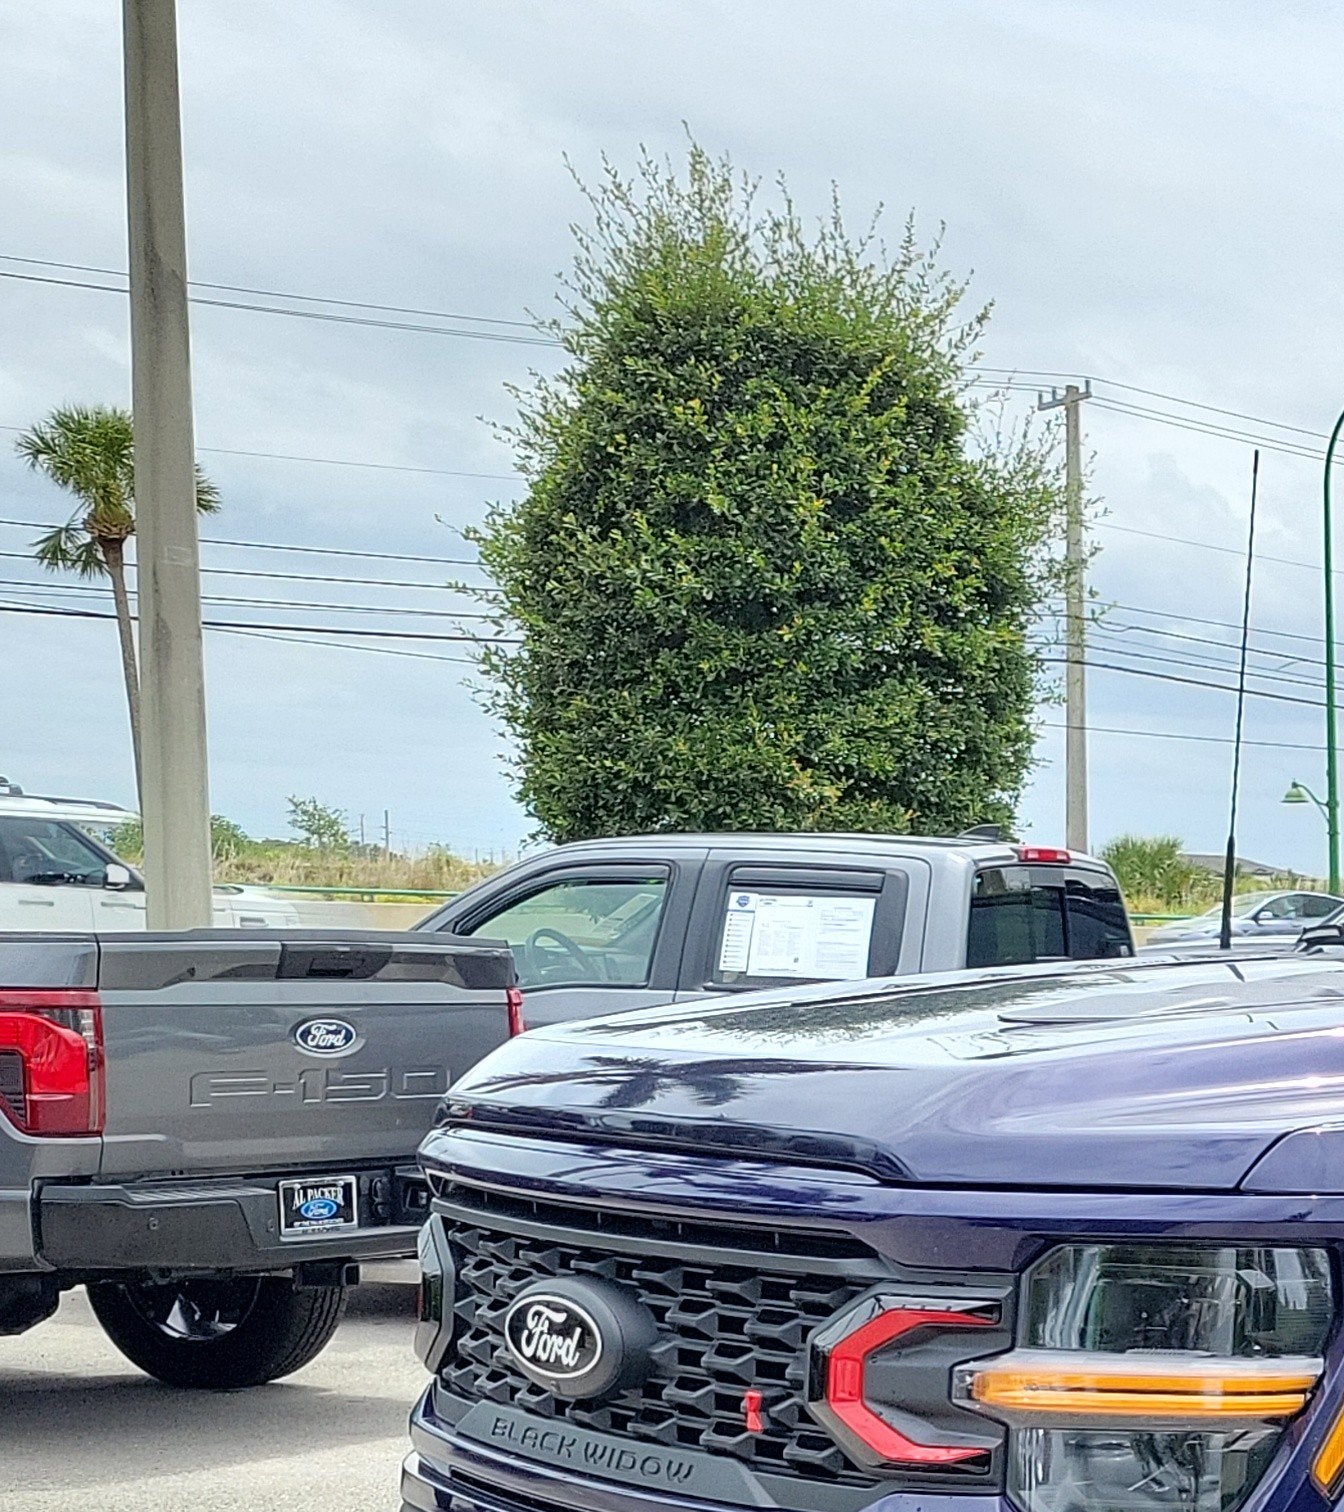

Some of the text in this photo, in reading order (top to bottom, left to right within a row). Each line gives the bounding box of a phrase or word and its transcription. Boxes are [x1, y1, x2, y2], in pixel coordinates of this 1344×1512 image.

[306, 1022, 347, 1048] Ford
[189, 1065, 450, 1107] F-150
[521, 1304, 583, 1367] Ford
[490, 1417, 695, 1484] BLACK WIDOW
